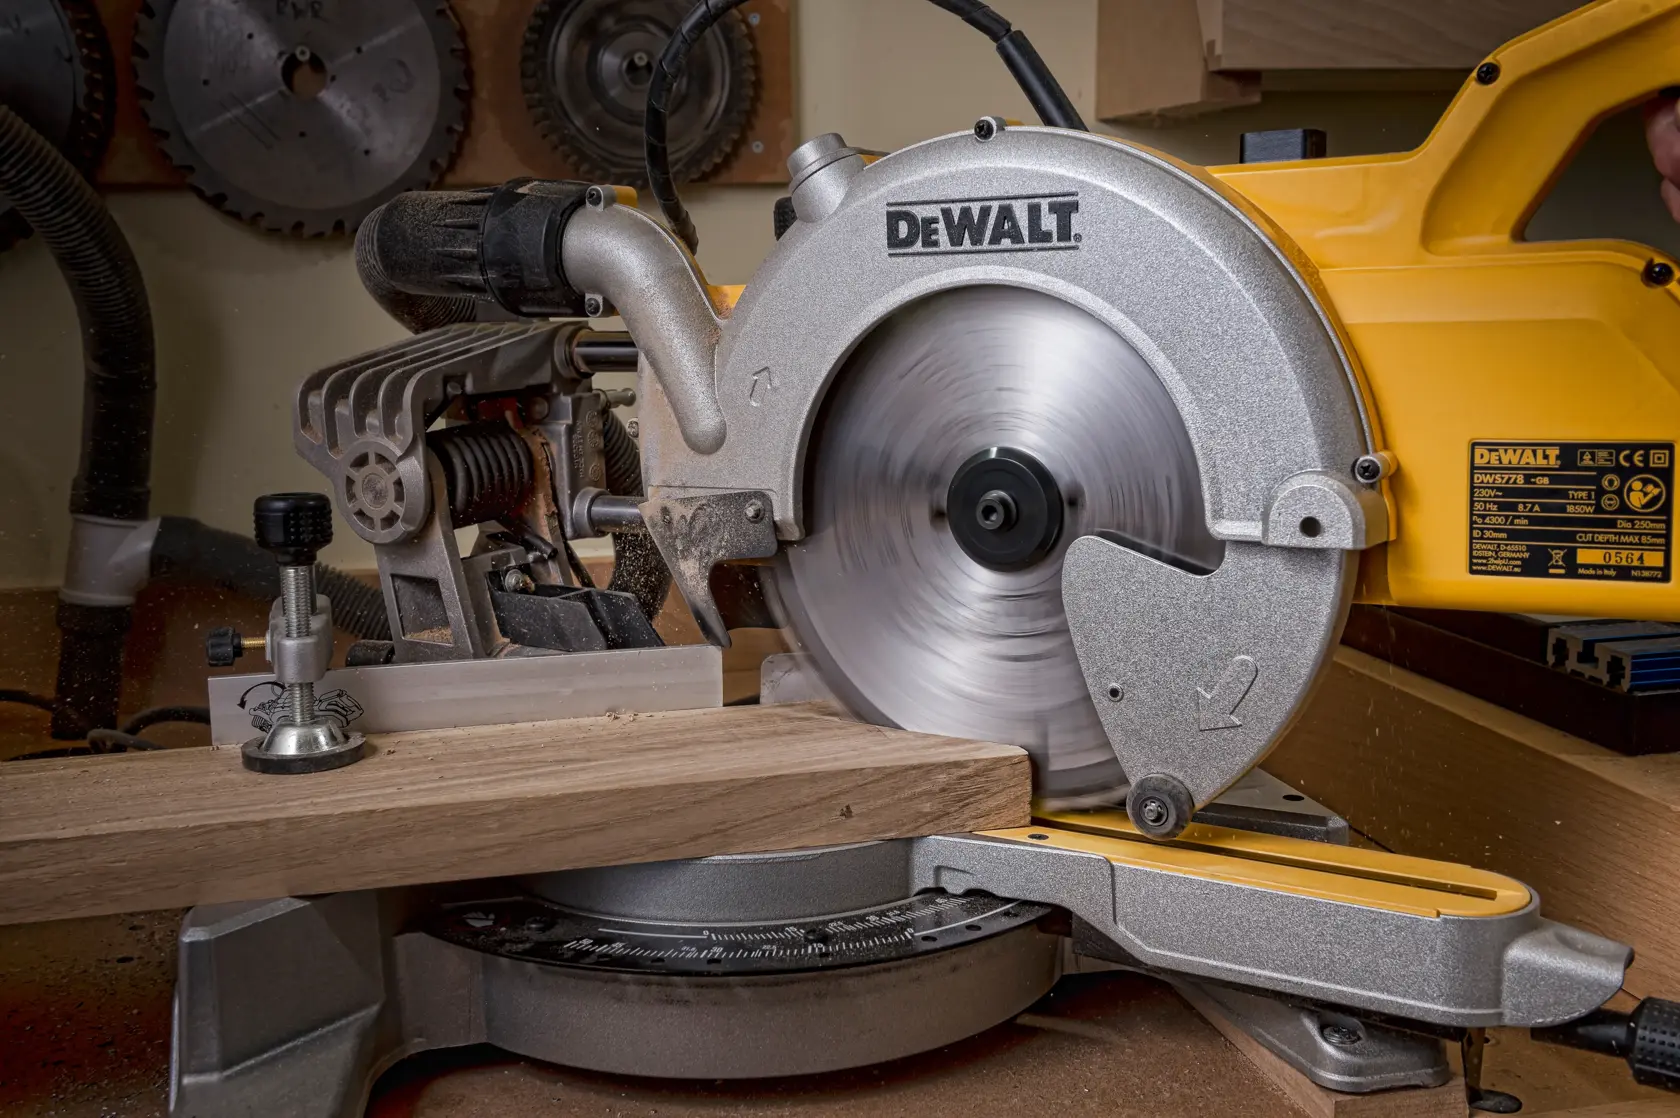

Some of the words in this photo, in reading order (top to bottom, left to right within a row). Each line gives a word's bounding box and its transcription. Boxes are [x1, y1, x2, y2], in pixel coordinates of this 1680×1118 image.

[1473, 474, 1525, 484] DWS778
[1568, 491, 1589, 500] TYPE
[1473, 502, 1485, 511] 50
[1486, 503, 1498, 511] Hz
[1517, 504, 1532, 512] 8.7
[1532, 504, 1541, 512] A
[1566, 505, 1595, 514] 1850W
[1484, 516, 1506, 525] 4300
[1513, 517, 1529, 525] min
[1617, 520, 1632, 528] Dia
[1633, 521, 1666, 529] 250mm
[1472, 530, 1482, 538] ID
[1483, 530, 1507, 539] 30mm
[1576, 533, 1593, 541] CUT
[1593, 534, 1619, 542] DEPTH
[1620, 535, 1639, 543] MAX
[1641, 535, 1666, 544] 85mm
[1603, 551, 1645, 565] 0564
[1603, 568, 1617, 577] Italy
